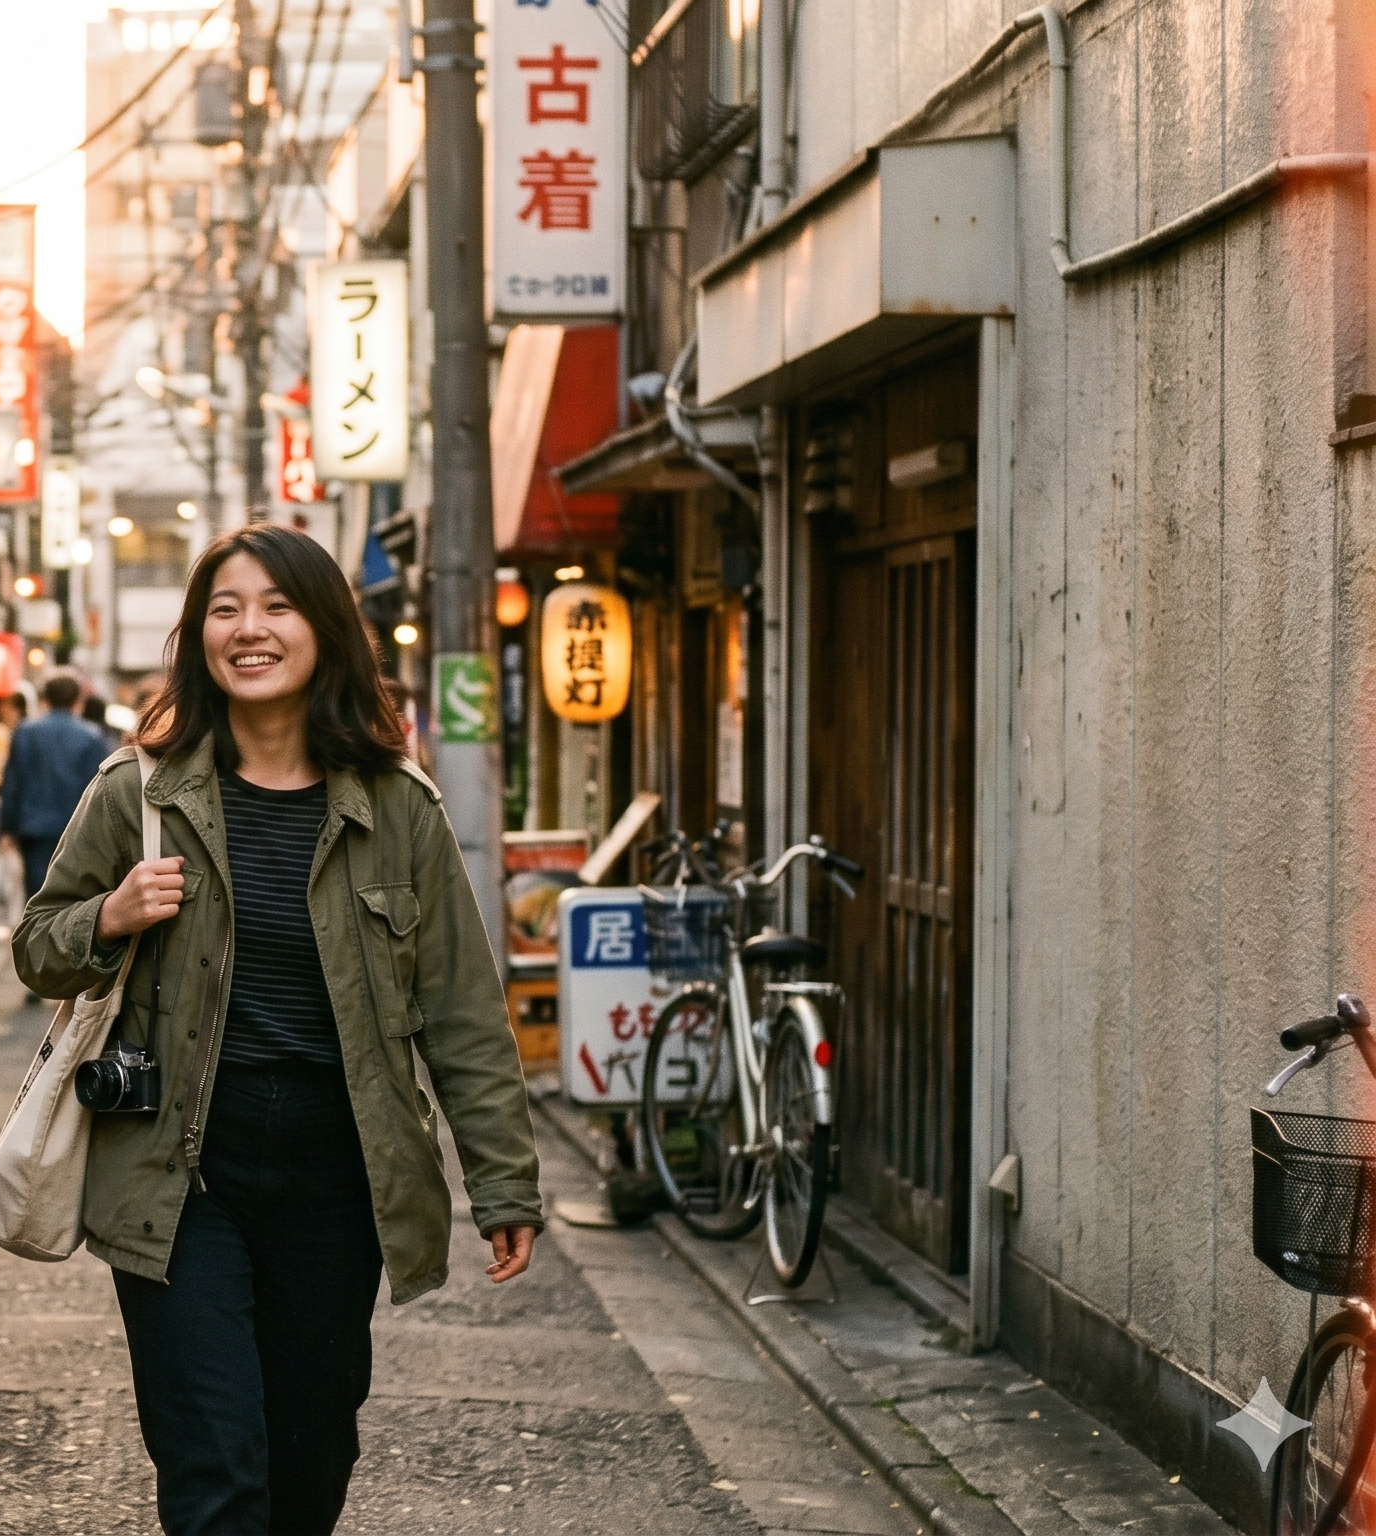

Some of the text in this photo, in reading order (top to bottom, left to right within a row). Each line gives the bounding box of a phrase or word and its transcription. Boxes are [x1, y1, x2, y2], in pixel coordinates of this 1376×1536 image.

[517, 43, 598, 231] 古着
[340, 279, 379, 461] ラーメン
[566, 600, 606, 706] 赤提灯
